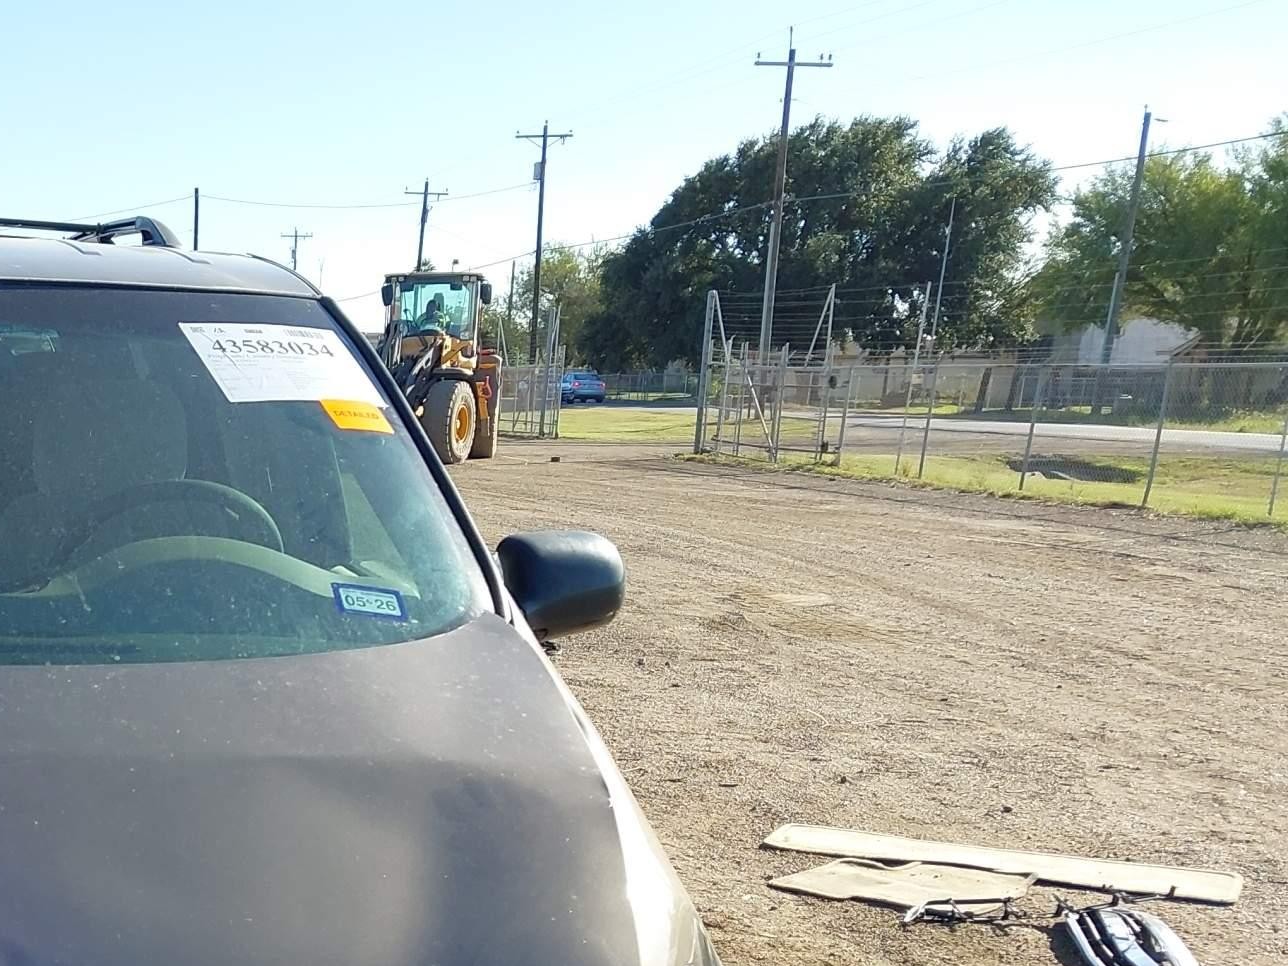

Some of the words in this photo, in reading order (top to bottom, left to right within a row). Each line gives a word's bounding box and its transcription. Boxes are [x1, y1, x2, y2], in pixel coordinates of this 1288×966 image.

[211, 338, 334, 357] 43583034
[344, 594, 367, 608] 05
[374, 598, 397, 612] 26
